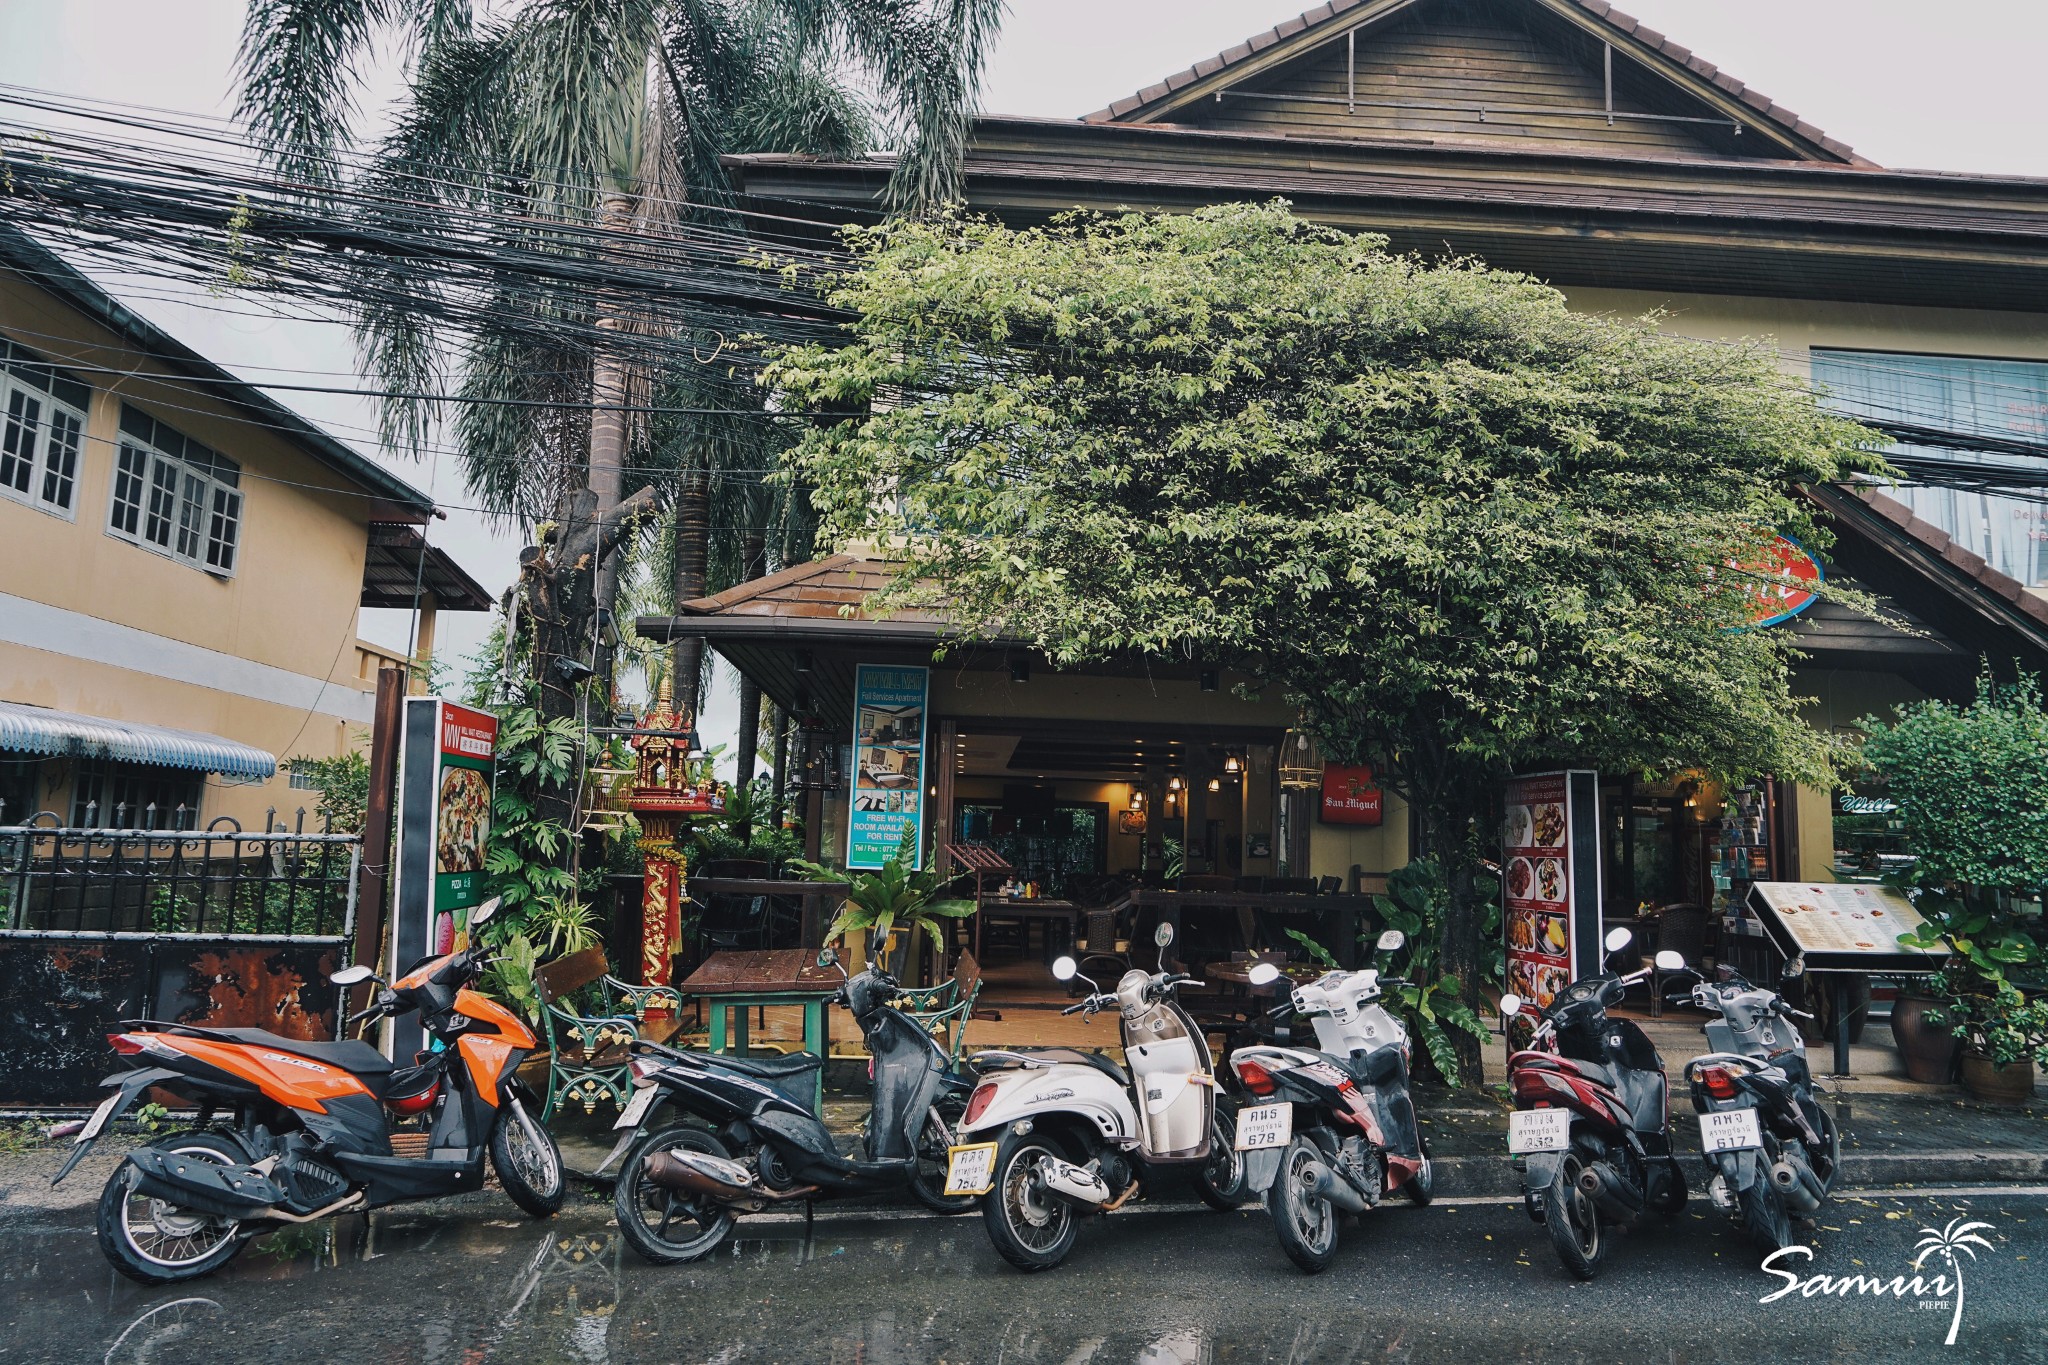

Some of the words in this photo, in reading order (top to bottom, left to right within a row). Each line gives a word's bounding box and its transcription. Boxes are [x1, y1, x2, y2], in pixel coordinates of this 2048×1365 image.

[861, 691, 872, 700] Full
[872, 692, 894, 701] Services
[895, 693, 922, 703] Apartment
[1325, 796, 1344, 808] San
[1345, 797, 1378, 811] Miguel
[1840, 795, 1890, 813] Will
[867, 814, 886, 822] FREE
[854, 823, 876, 831] ROOM
[867, 832, 882, 840] FOR
[884, 833, 903, 841] RENT
[855, 844, 864, 852] Tel
[867, 845, 878, 853] Fax
[1248, 1132, 1276, 1146] 678
[1716, 1135, 1746, 1149] 617
